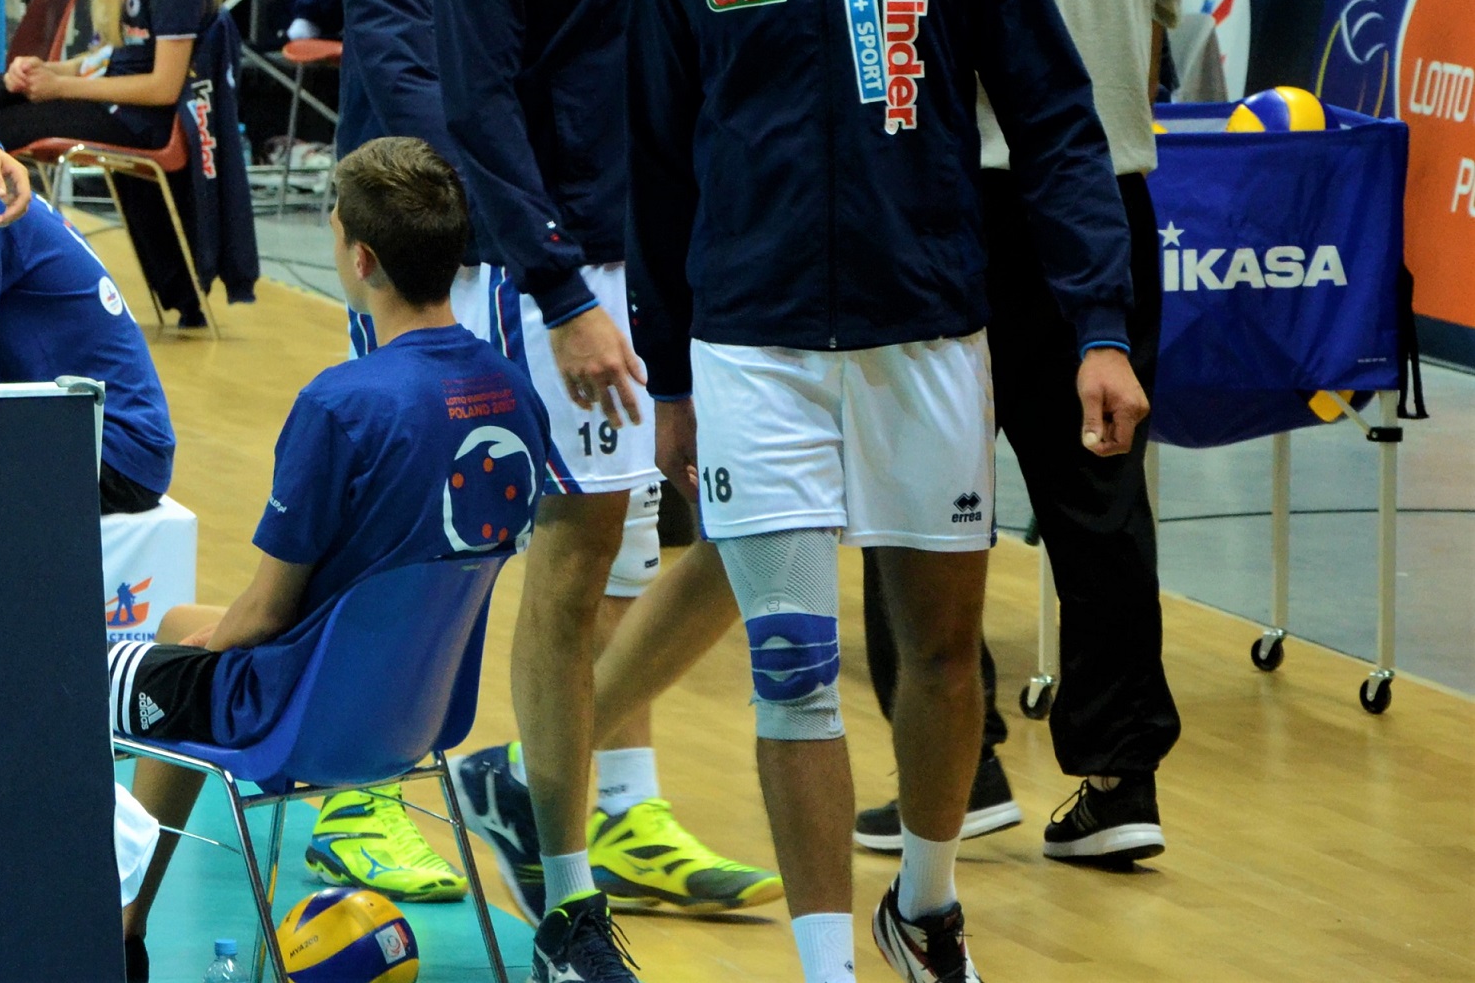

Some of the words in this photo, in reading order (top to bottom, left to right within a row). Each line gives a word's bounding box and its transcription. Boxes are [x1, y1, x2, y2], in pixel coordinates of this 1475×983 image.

[856, 21, 883, 91] SPORT
[1409, 57, 1474, 122] LOTTO
[1162, 244, 1348, 293] IKASA
[448, 404, 490, 420] POLAND
[578, 420, 619, 456] 19
[702, 467, 733, 503] 18
[951, 511, 982, 523] errea
[109, 633, 156, 642] CZECIN
[138, 692, 149, 730] adidas
